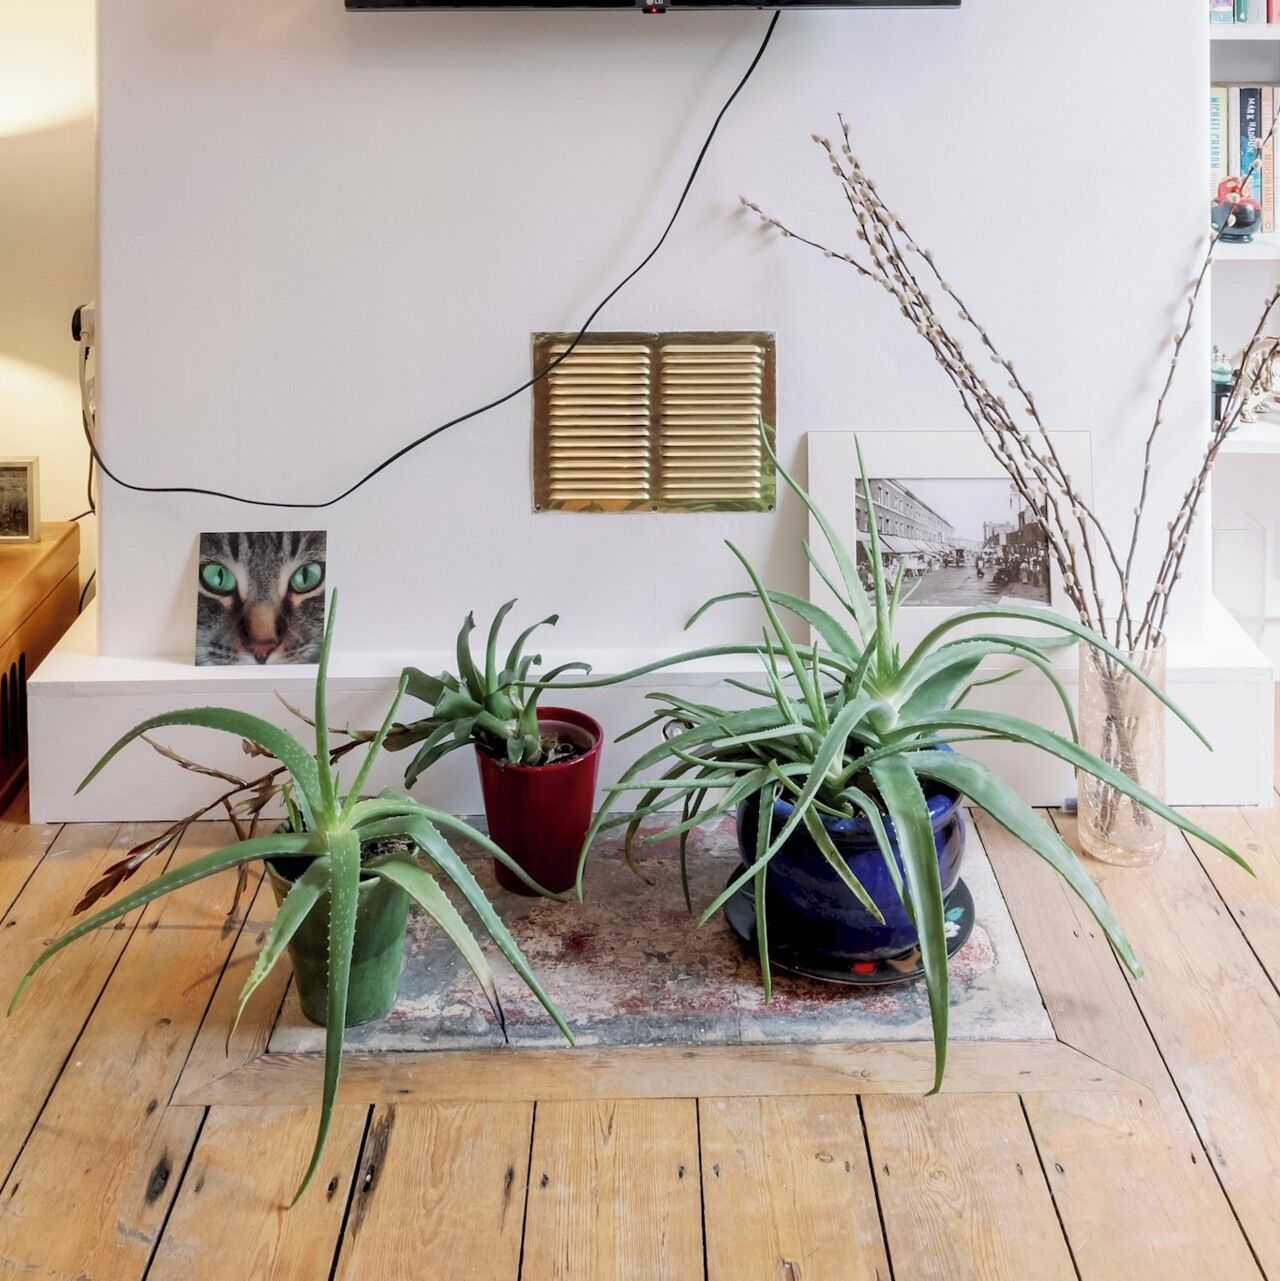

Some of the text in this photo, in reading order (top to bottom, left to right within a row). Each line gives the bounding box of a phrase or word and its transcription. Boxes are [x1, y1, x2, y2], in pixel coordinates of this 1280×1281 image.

[1246, 98, 1256, 153] MARK HADDON
[1263, 154, 1272, 183] MOHSIN
